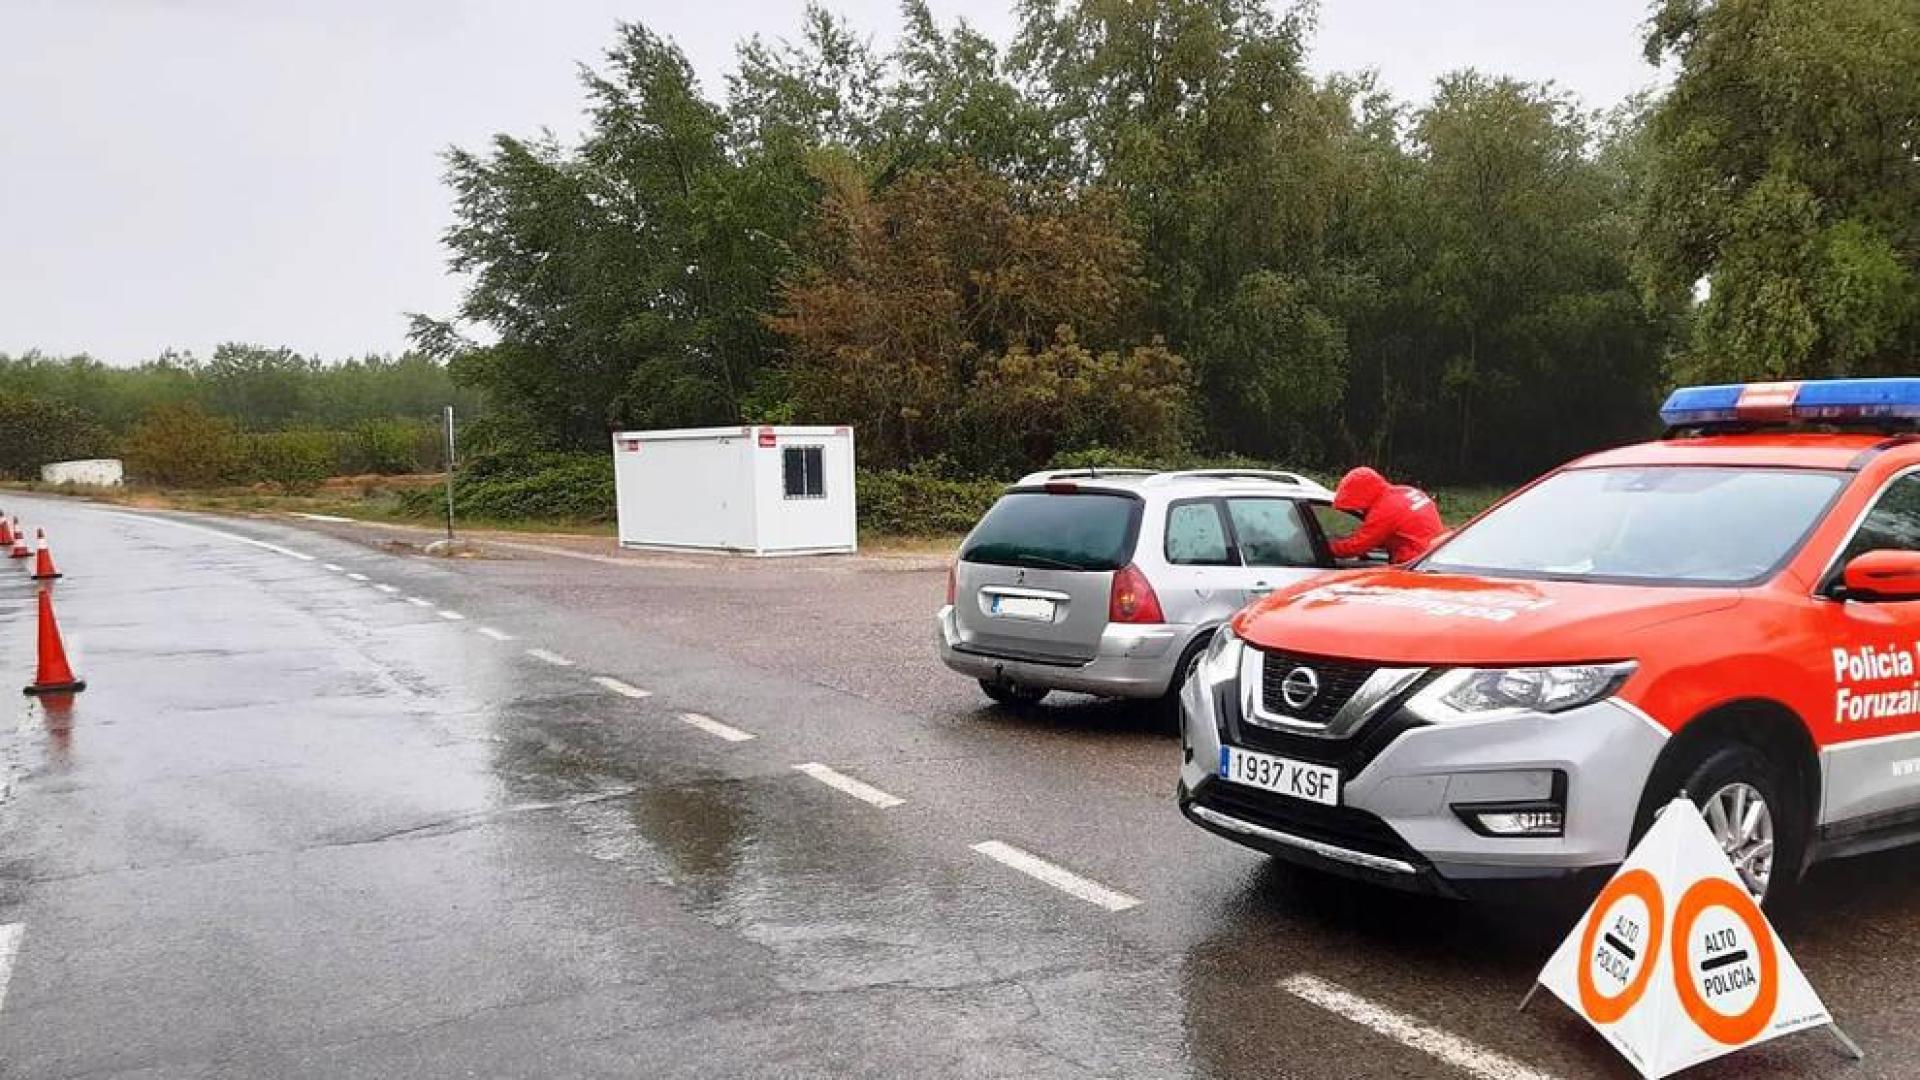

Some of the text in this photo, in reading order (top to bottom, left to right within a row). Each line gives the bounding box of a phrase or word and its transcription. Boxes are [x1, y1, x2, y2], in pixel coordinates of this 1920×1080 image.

[1836, 681, 1920, 723] Foruzai
[1236, 752, 1333, 800] 1937 KSF
[1704, 928, 1737, 954] ALTO
